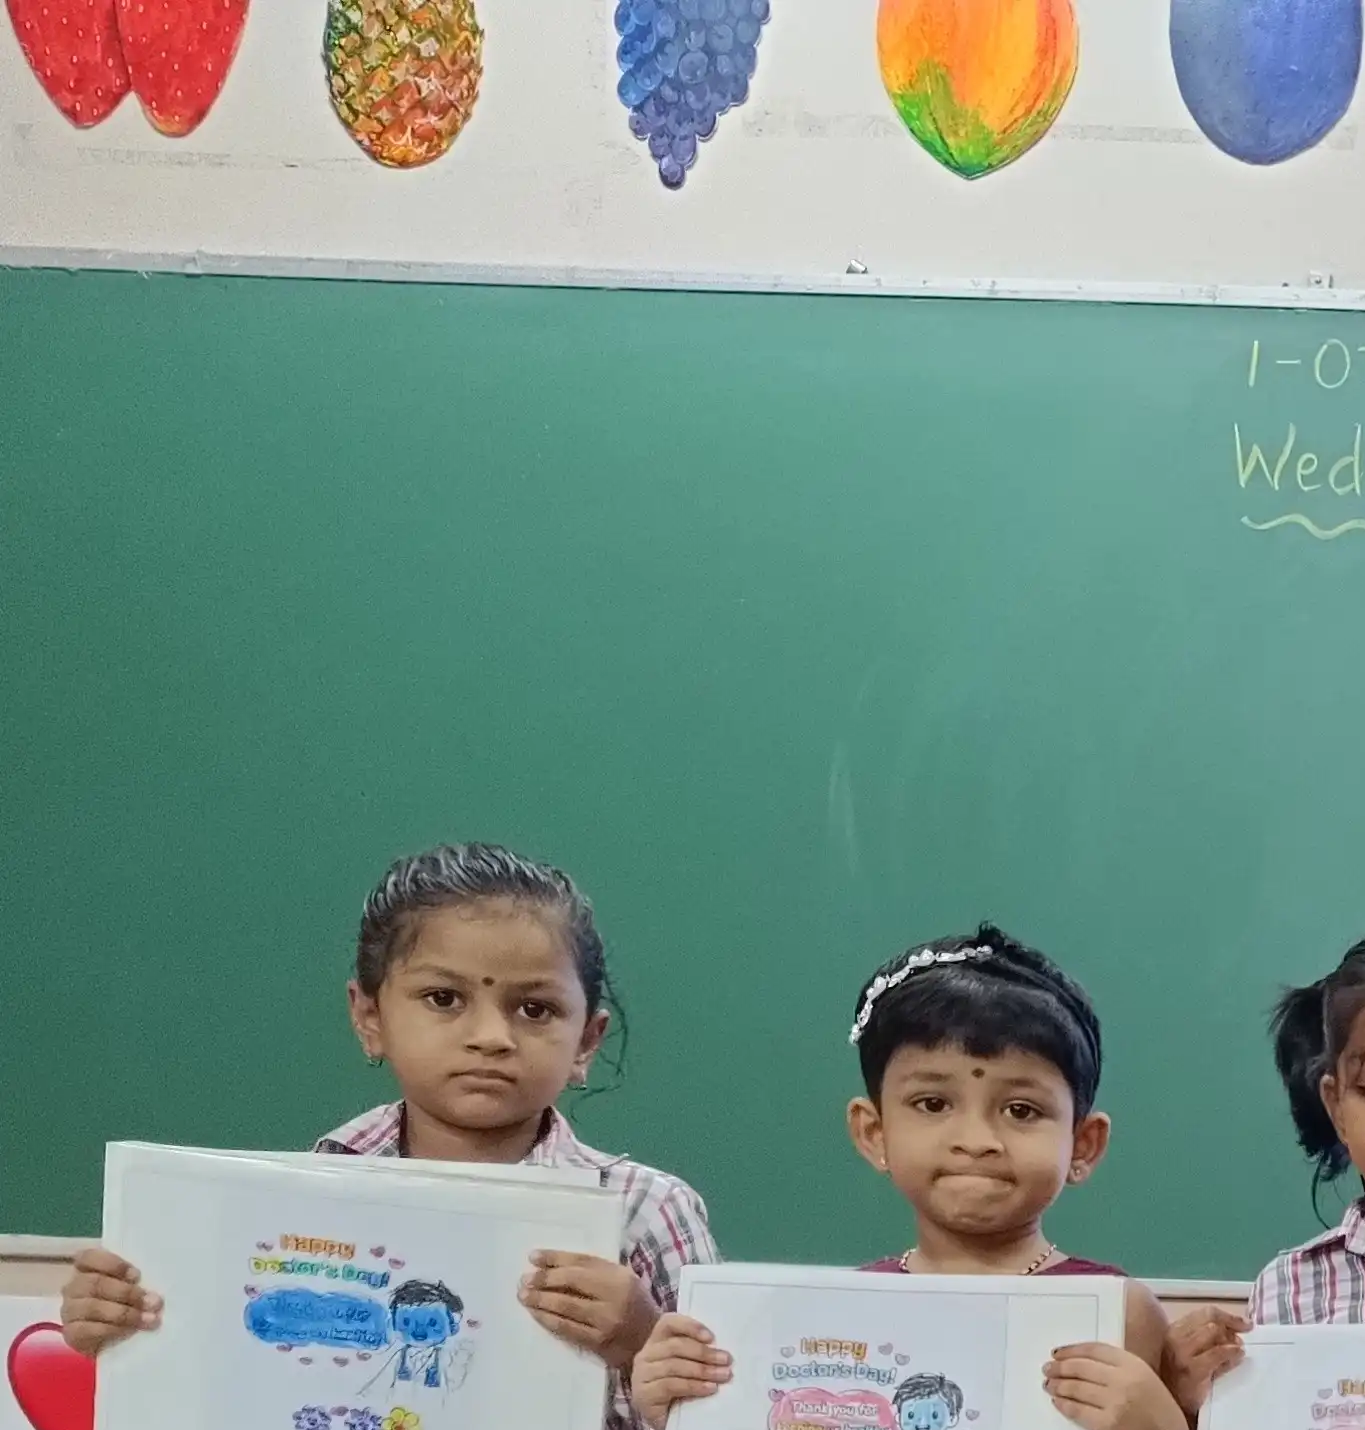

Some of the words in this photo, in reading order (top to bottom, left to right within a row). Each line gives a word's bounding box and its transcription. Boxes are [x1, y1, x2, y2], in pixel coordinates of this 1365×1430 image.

[801, 1337, 868, 1361] Happy
[772, 1361, 852, 1381] Doctor's
[855, 1362, 898, 1387] Day!
[791, 1401, 829, 1415] Thank
[832, 1405, 855, 1417] you
[858, 1402, 878, 1416] for
